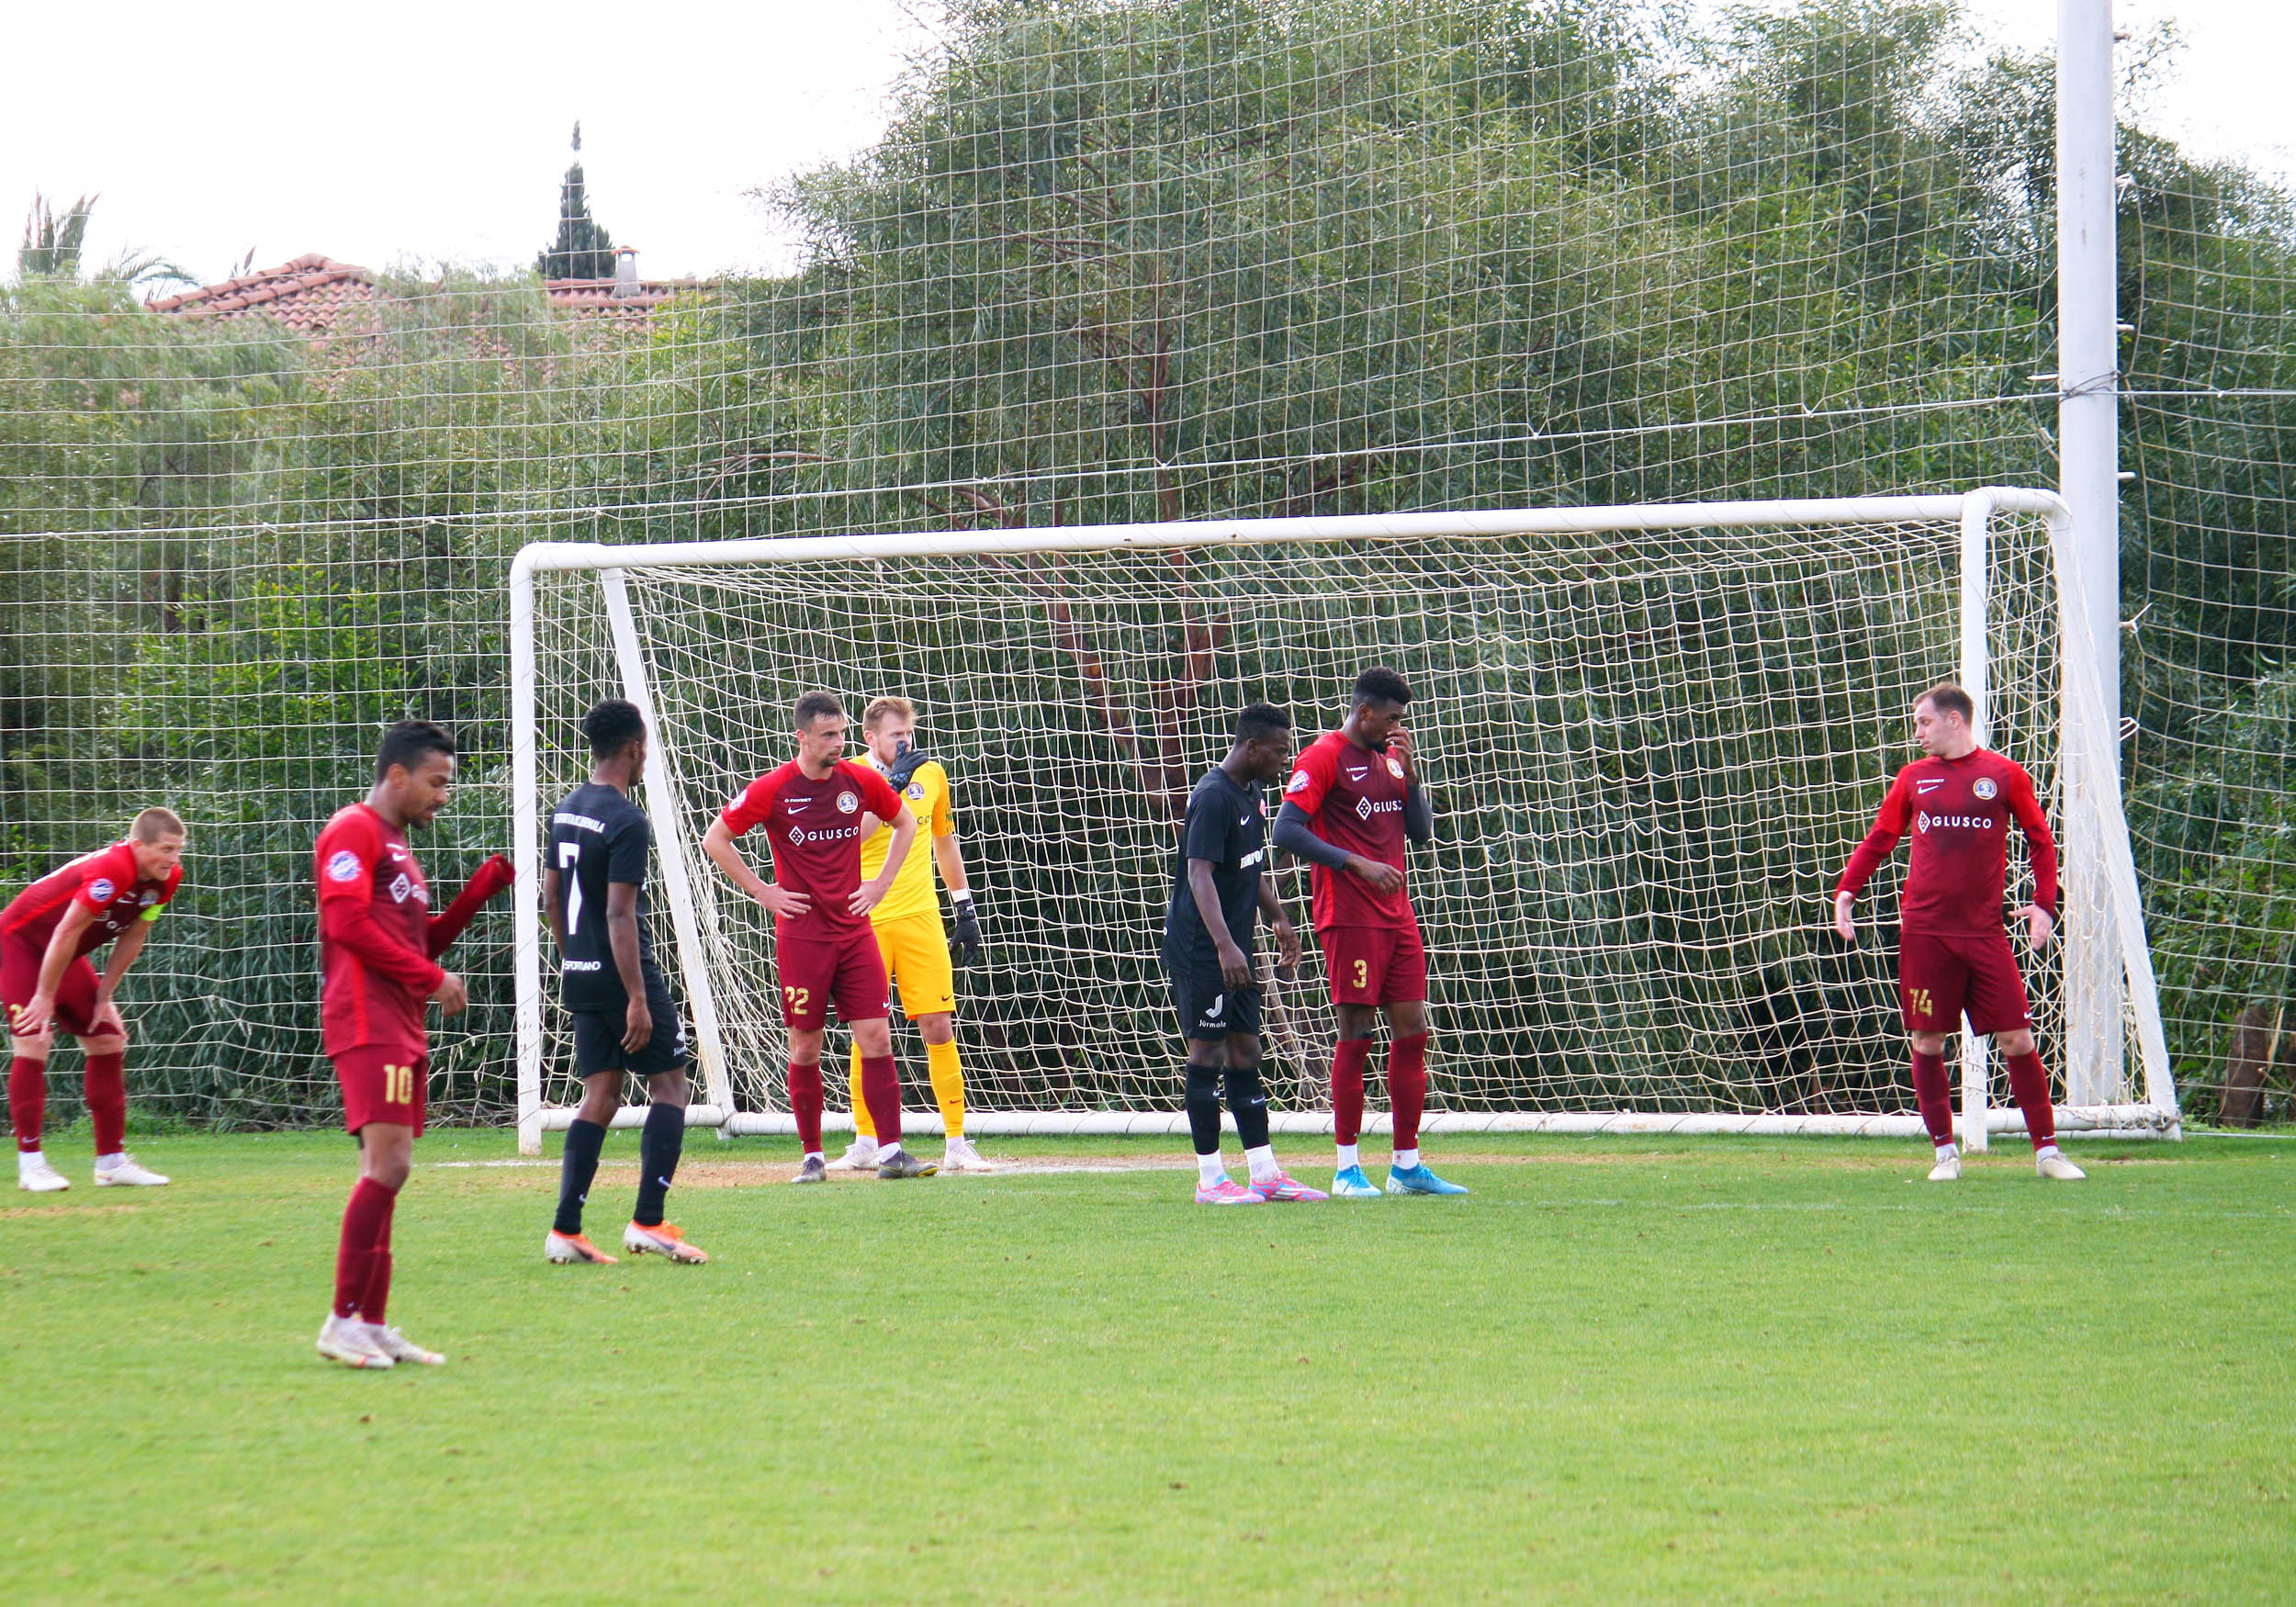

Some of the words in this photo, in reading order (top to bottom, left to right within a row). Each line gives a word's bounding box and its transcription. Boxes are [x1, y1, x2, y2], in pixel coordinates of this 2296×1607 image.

[807, 826, 859, 841] GLUSCO
[1931, 815, 1992, 829] GLUSCO
[558, 842, 582, 935] 7
[1353, 959, 1367, 988] 3
[784, 986, 809, 1015] 22
[383, 1063, 412, 1105] 10
